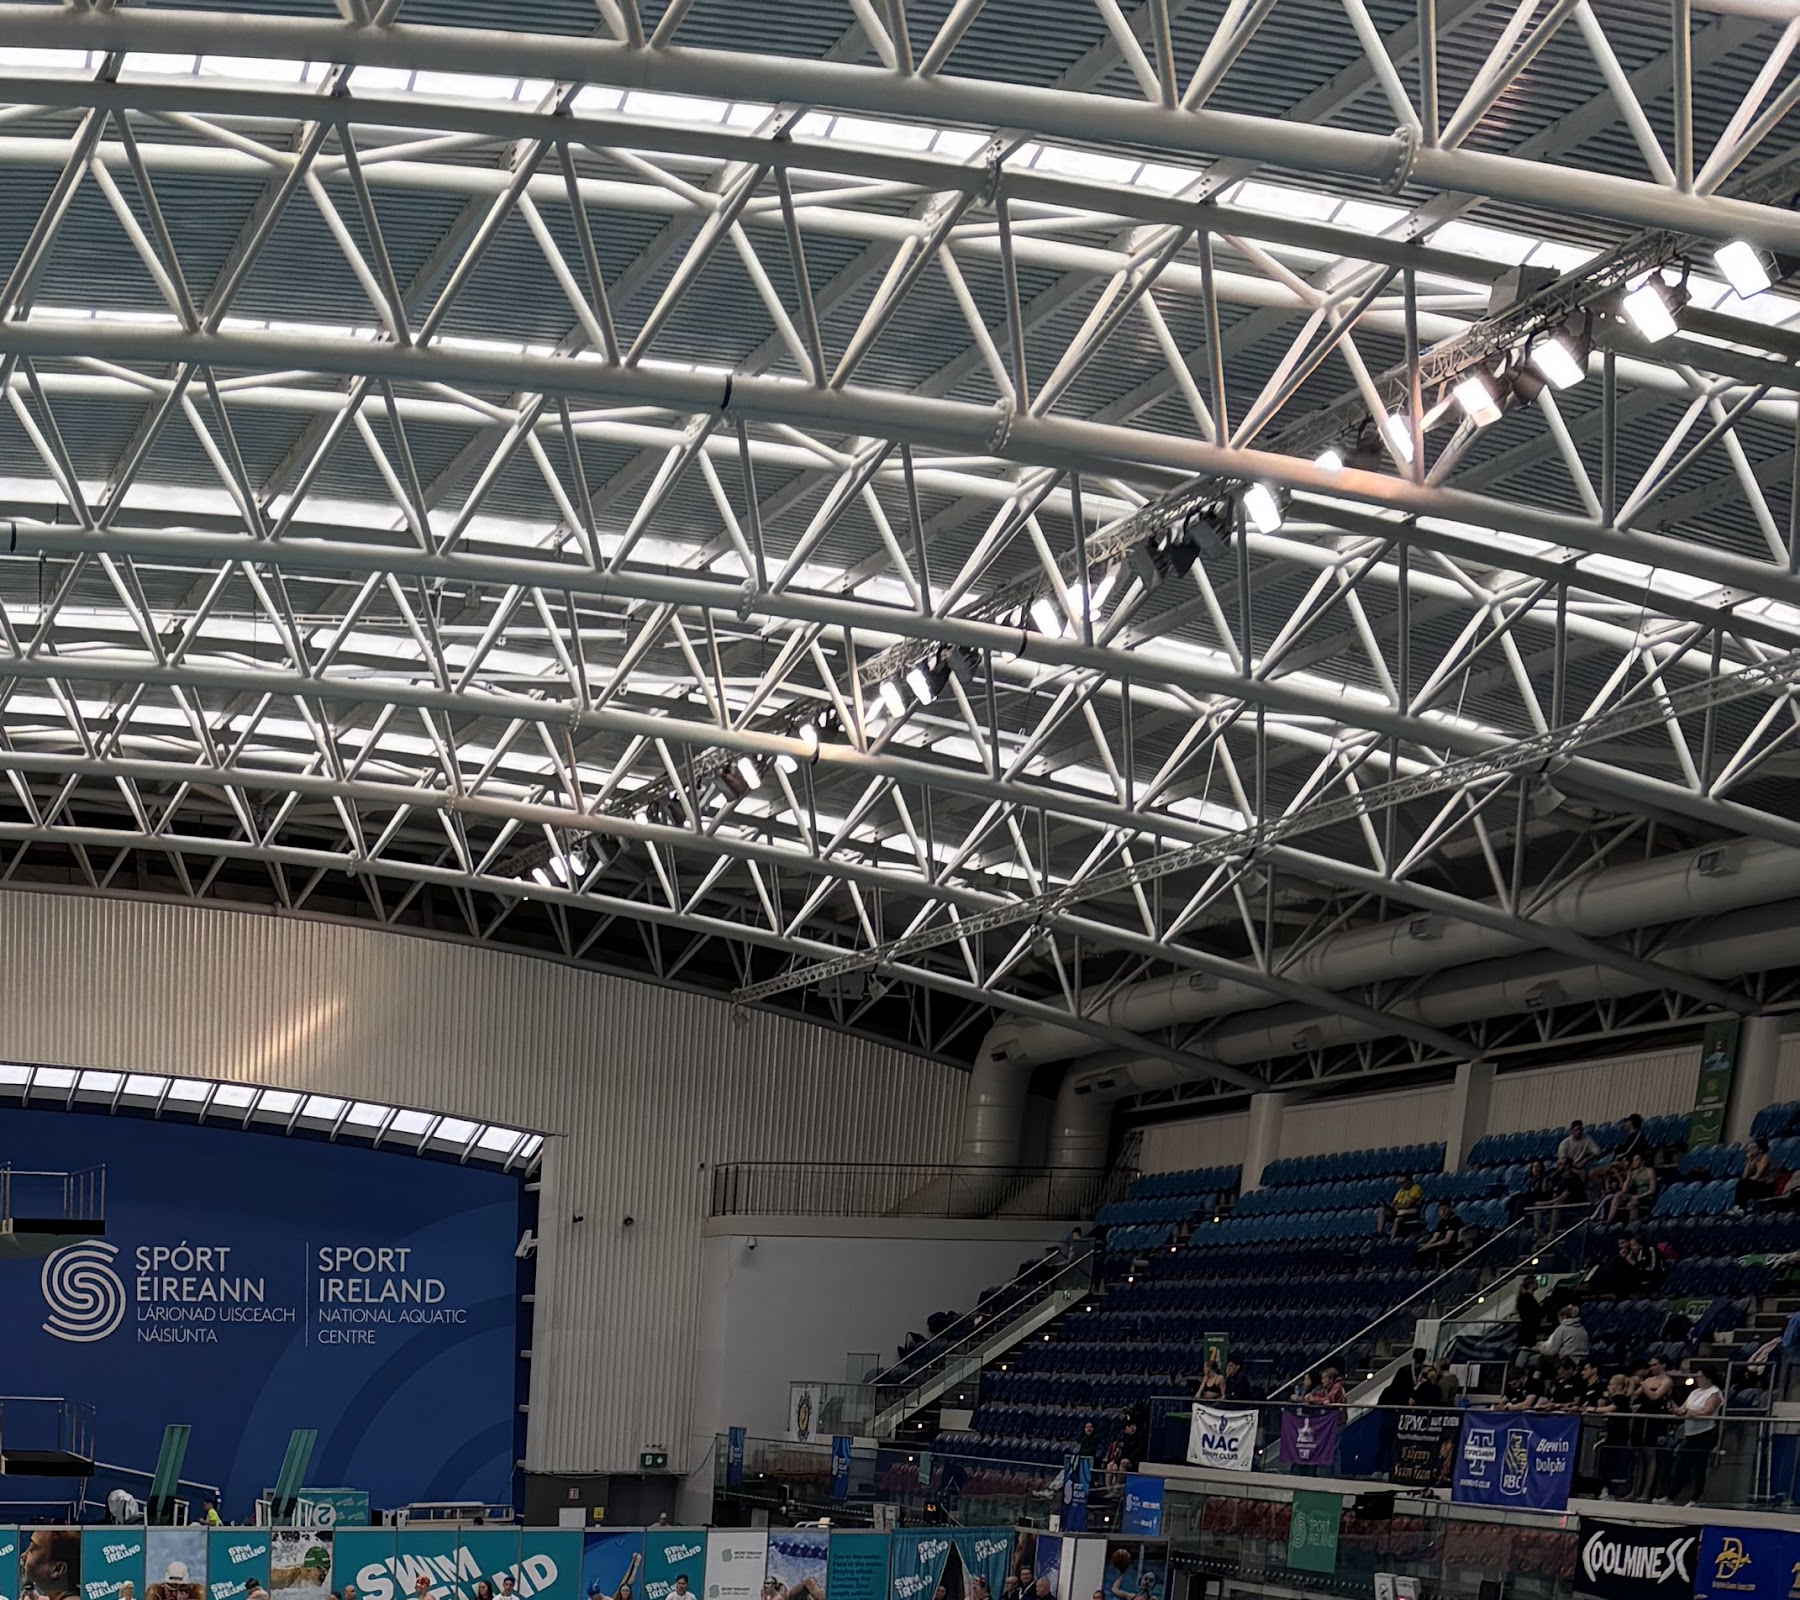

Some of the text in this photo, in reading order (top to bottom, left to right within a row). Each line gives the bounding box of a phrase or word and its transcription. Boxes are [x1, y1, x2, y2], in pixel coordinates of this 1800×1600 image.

[135, 1240, 231, 1272] SPÓRT
[318, 1247, 411, 1273] SPORT
[136, 1270, 265, 1302] ÉIREANN
[319, 1278, 445, 1303] IRELAND
[137, 1304, 296, 1322] LÁRIONAD UISCEACH
[319, 1308, 467, 1324] NATIONAL AQUATIC
[137, 1324, 218, 1343] NÁISIÚNTA
[317, 1329, 376, 1344] CENTRE
[1398, 1414, 1429, 1432] UPMC
[1202, 1433, 1239, 1452] NAC
[1535, 1438, 1569, 1453] Brewin
